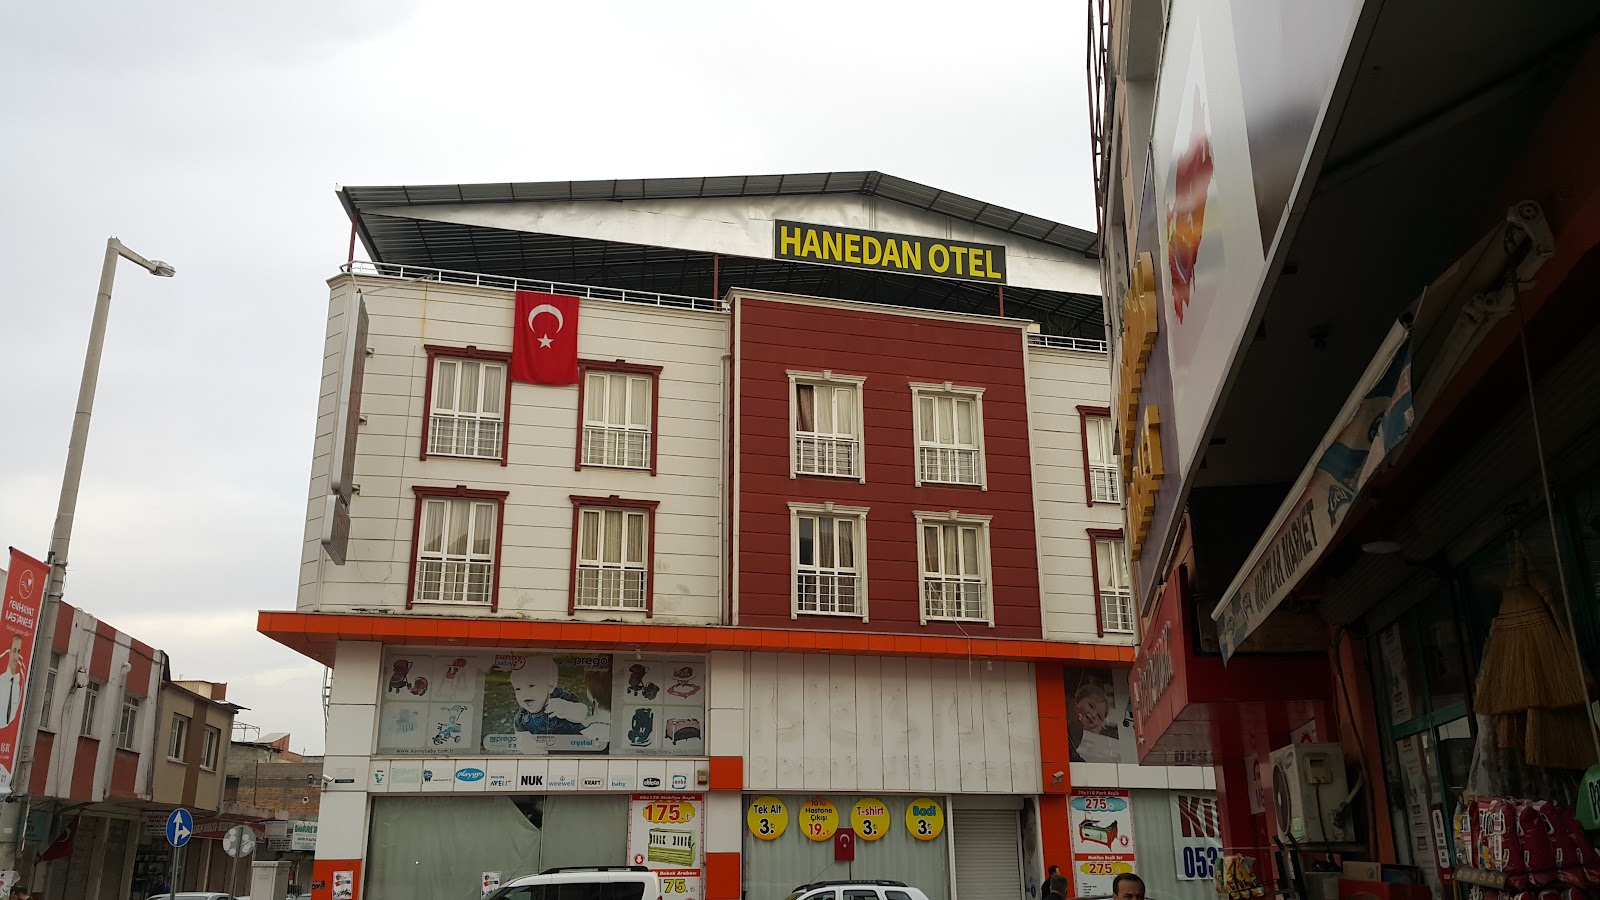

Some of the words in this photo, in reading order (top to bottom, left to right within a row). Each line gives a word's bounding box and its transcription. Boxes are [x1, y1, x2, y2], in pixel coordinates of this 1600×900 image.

[780, 225, 922, 271] HANEDAN
[928, 243, 1002, 279] OTEL
[494, 653, 523, 661] sunny
[573, 655, 609, 668] prego
[494, 660, 514, 668] baby
[495, 735, 517, 744] prego
[570, 739, 594, 747] crystal
[456, 769, 484, 780] playgro
[520, 775, 543, 786] NUK
[548, 779, 576, 787] weewell
[754, 804, 769, 814] Tek
[770, 804, 782, 814] Alt
[1085, 798, 1107, 810] 275
[805, 807, 833, 815] Hastane
[856, 806, 885, 816] T-shirt
[810, 814, 828, 823] Çıkışı
[1183, 846, 1224, 878] 053
[1089, 863, 1112, 874] 275
